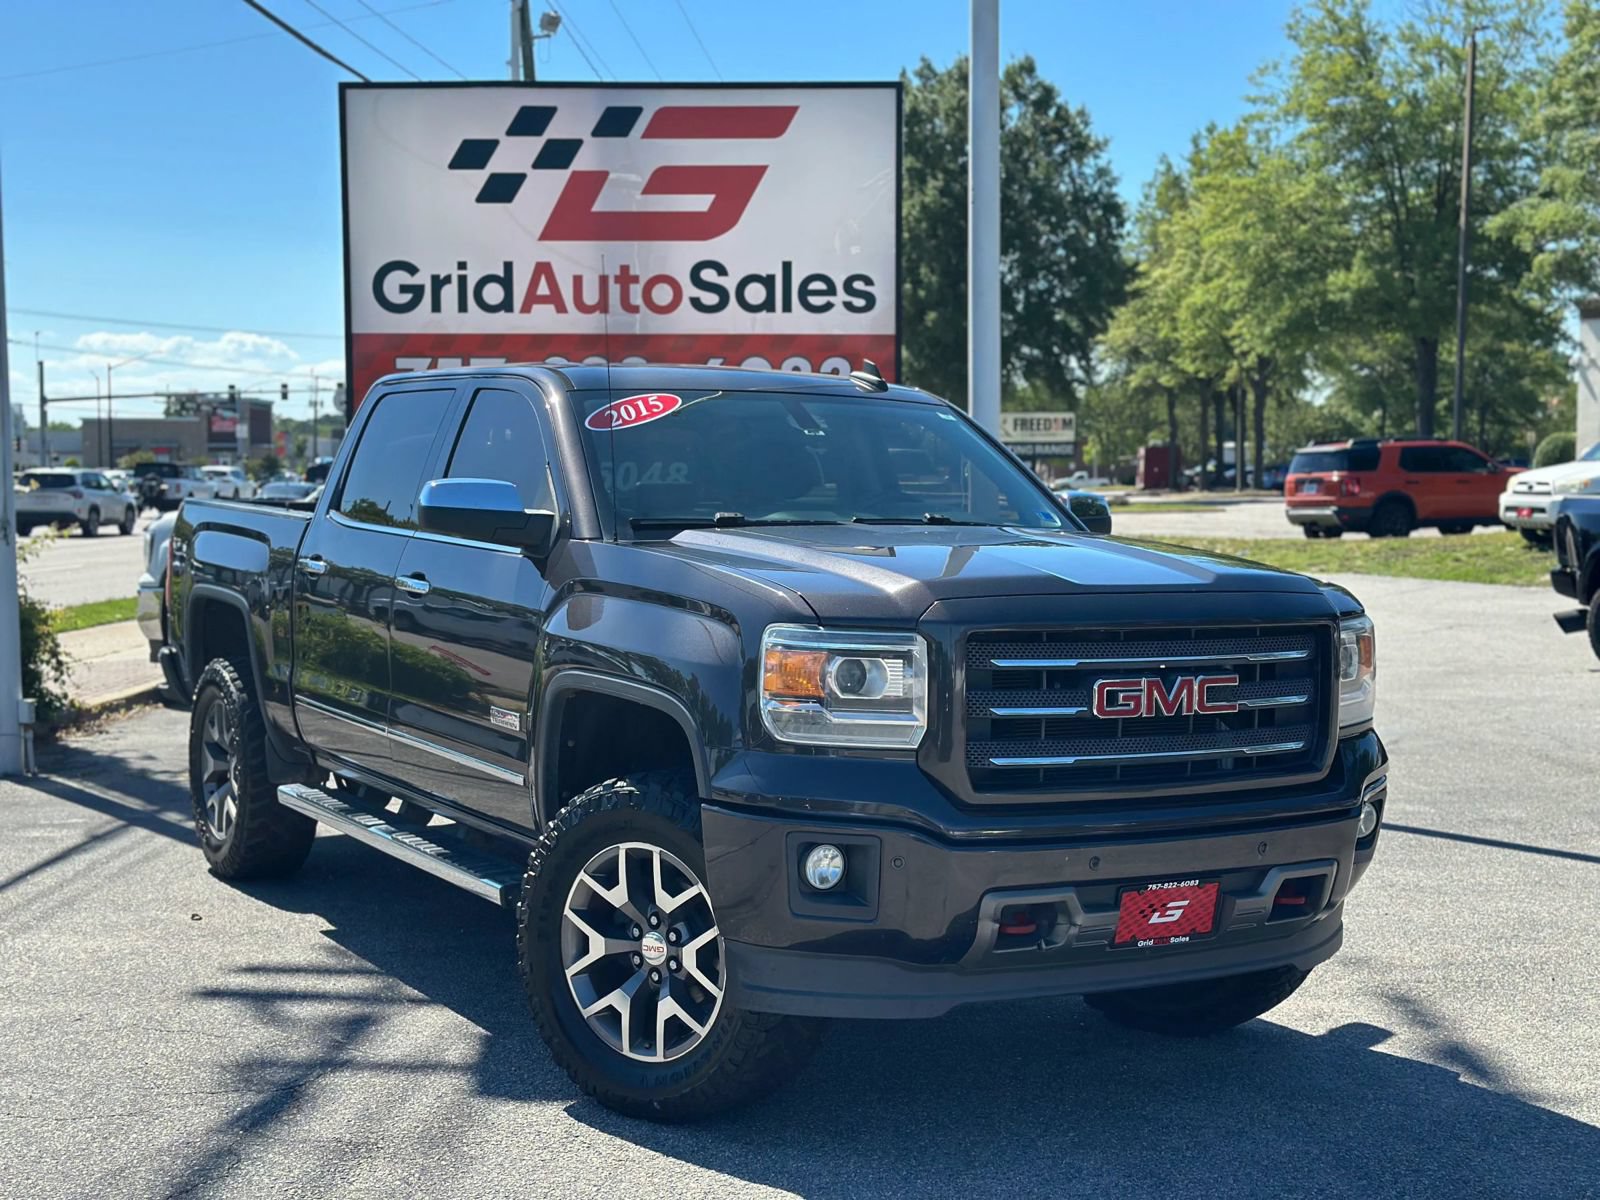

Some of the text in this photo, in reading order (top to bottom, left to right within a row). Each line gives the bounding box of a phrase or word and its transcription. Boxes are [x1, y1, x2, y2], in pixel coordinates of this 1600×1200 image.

[372, 259, 877, 314] GridAutoSales
[604, 396, 664, 427] 2015
[1014, 417, 1073, 432] FREEDM
[1093, 675, 1239, 718] GMC
